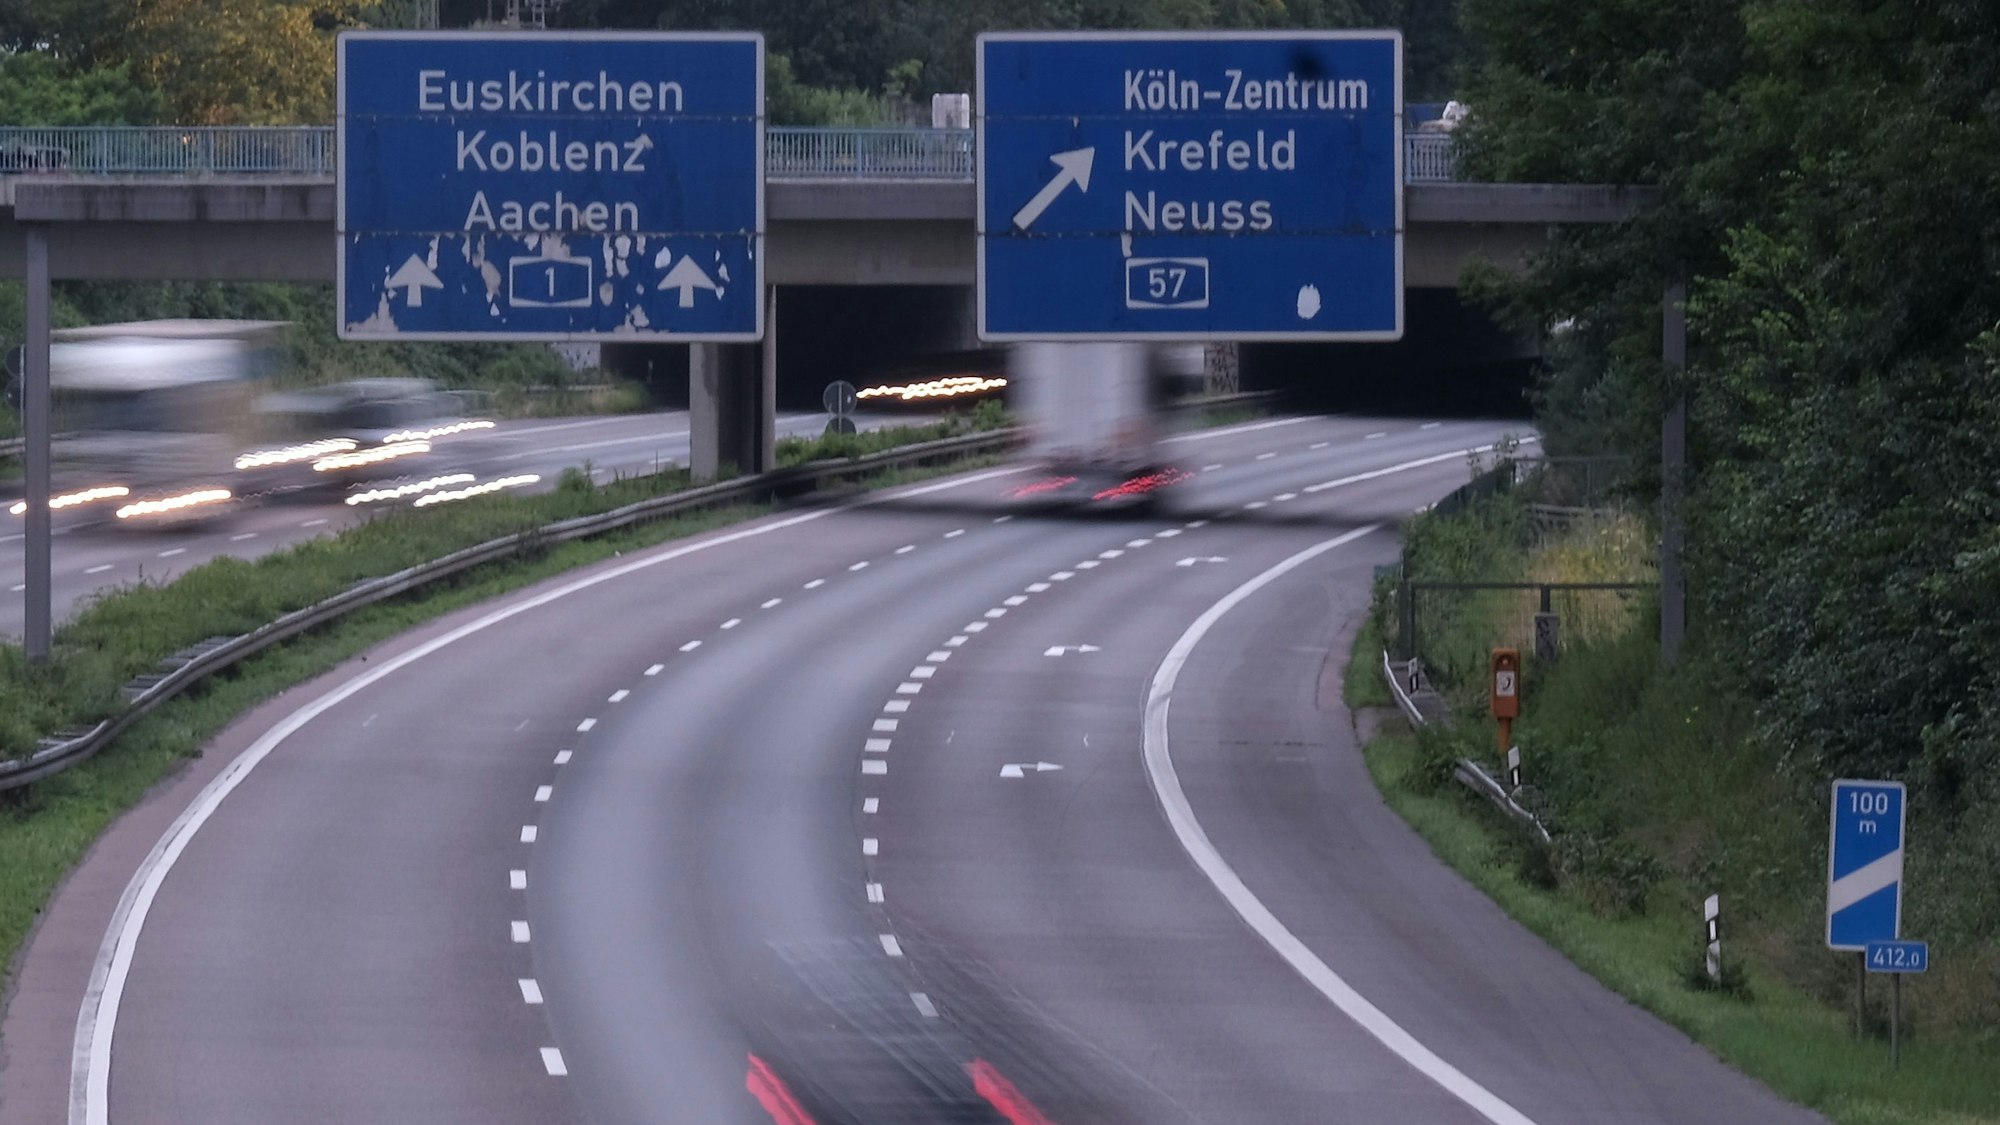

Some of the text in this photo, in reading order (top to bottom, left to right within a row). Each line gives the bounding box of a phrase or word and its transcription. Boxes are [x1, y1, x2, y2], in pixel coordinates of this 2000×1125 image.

[418, 69, 683, 111] Euskirchen
[1124, 69, 1368, 111] Köln-Zentrum
[456, 129, 647, 172] Koblenz
[1124, 129, 1296, 171] Krefeld
[463, 190, 639, 231] Aachen
[1125, 190, 1273, 231] Neuss
[544, 266, 555, 297] 1
[1148, 268, 1187, 298] 57
[1850, 792, 1888, 815] 100
[1859, 820, 1877, 834] m
[1873, 947, 1920, 967] 412.0
